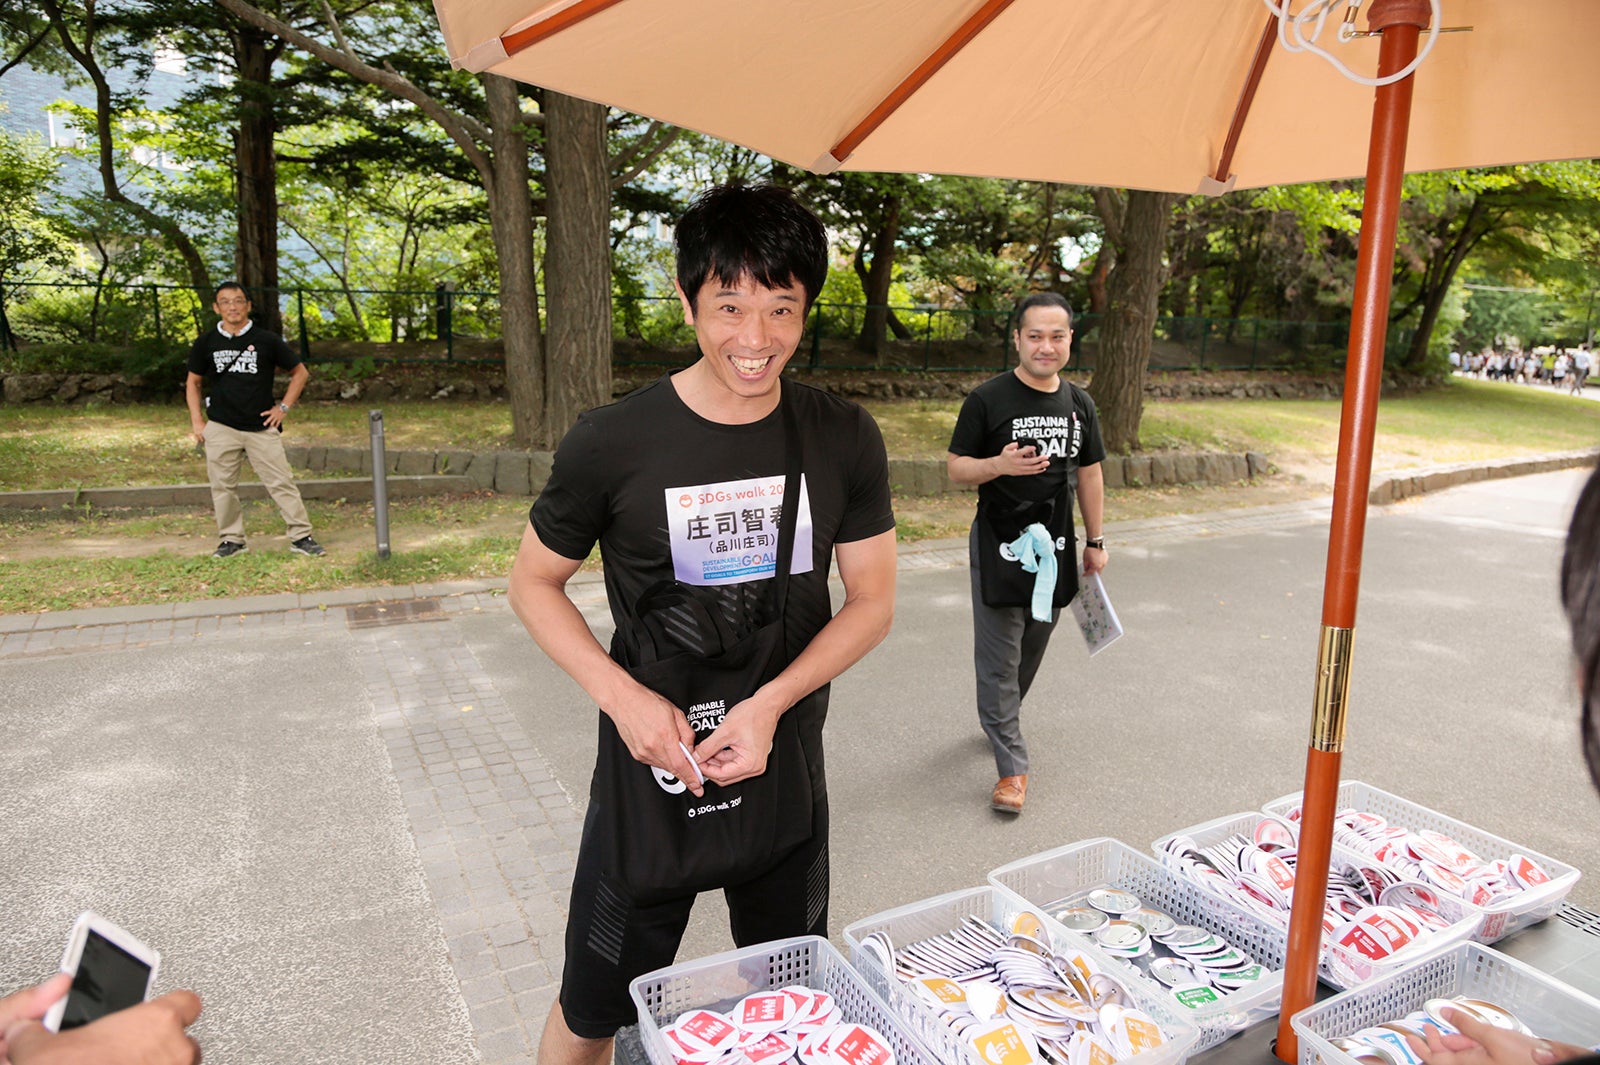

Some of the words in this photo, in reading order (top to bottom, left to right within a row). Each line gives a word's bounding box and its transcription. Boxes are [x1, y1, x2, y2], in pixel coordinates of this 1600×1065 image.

[698, 491, 732, 505] SDGs
[735, 486, 765, 499] walk
[769, 484, 784, 496] 20
[742, 552, 776, 567] GOAL
